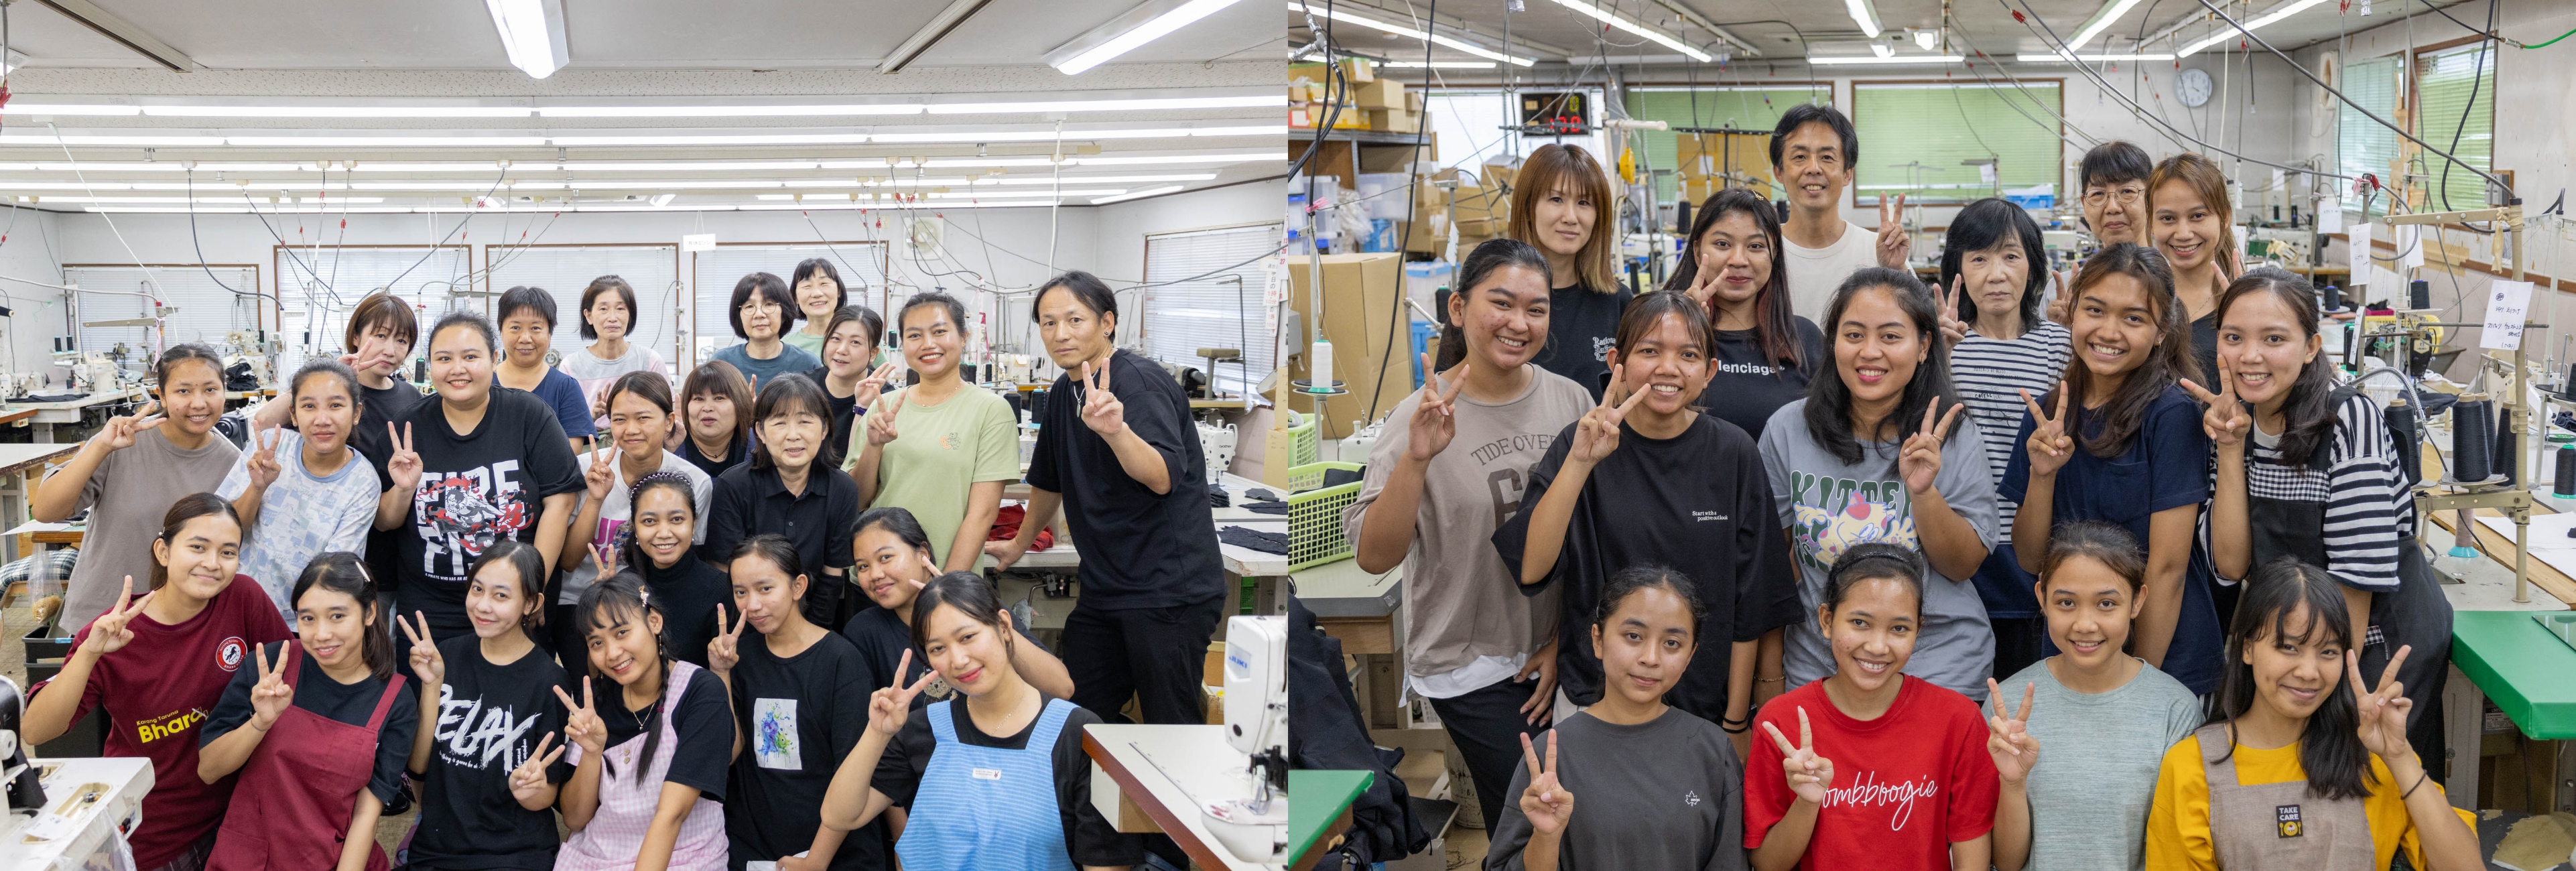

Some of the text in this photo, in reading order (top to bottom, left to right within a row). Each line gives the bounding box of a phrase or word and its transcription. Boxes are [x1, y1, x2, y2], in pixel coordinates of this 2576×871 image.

[1592, 336, 1616, 345] Rationa
[1718, 360, 1777, 375] lenciaga
[1470, 438, 1512, 466] TIDE
[157, 710, 179, 721] Taruna
[1822, 770, 1938, 831] ombboogie
